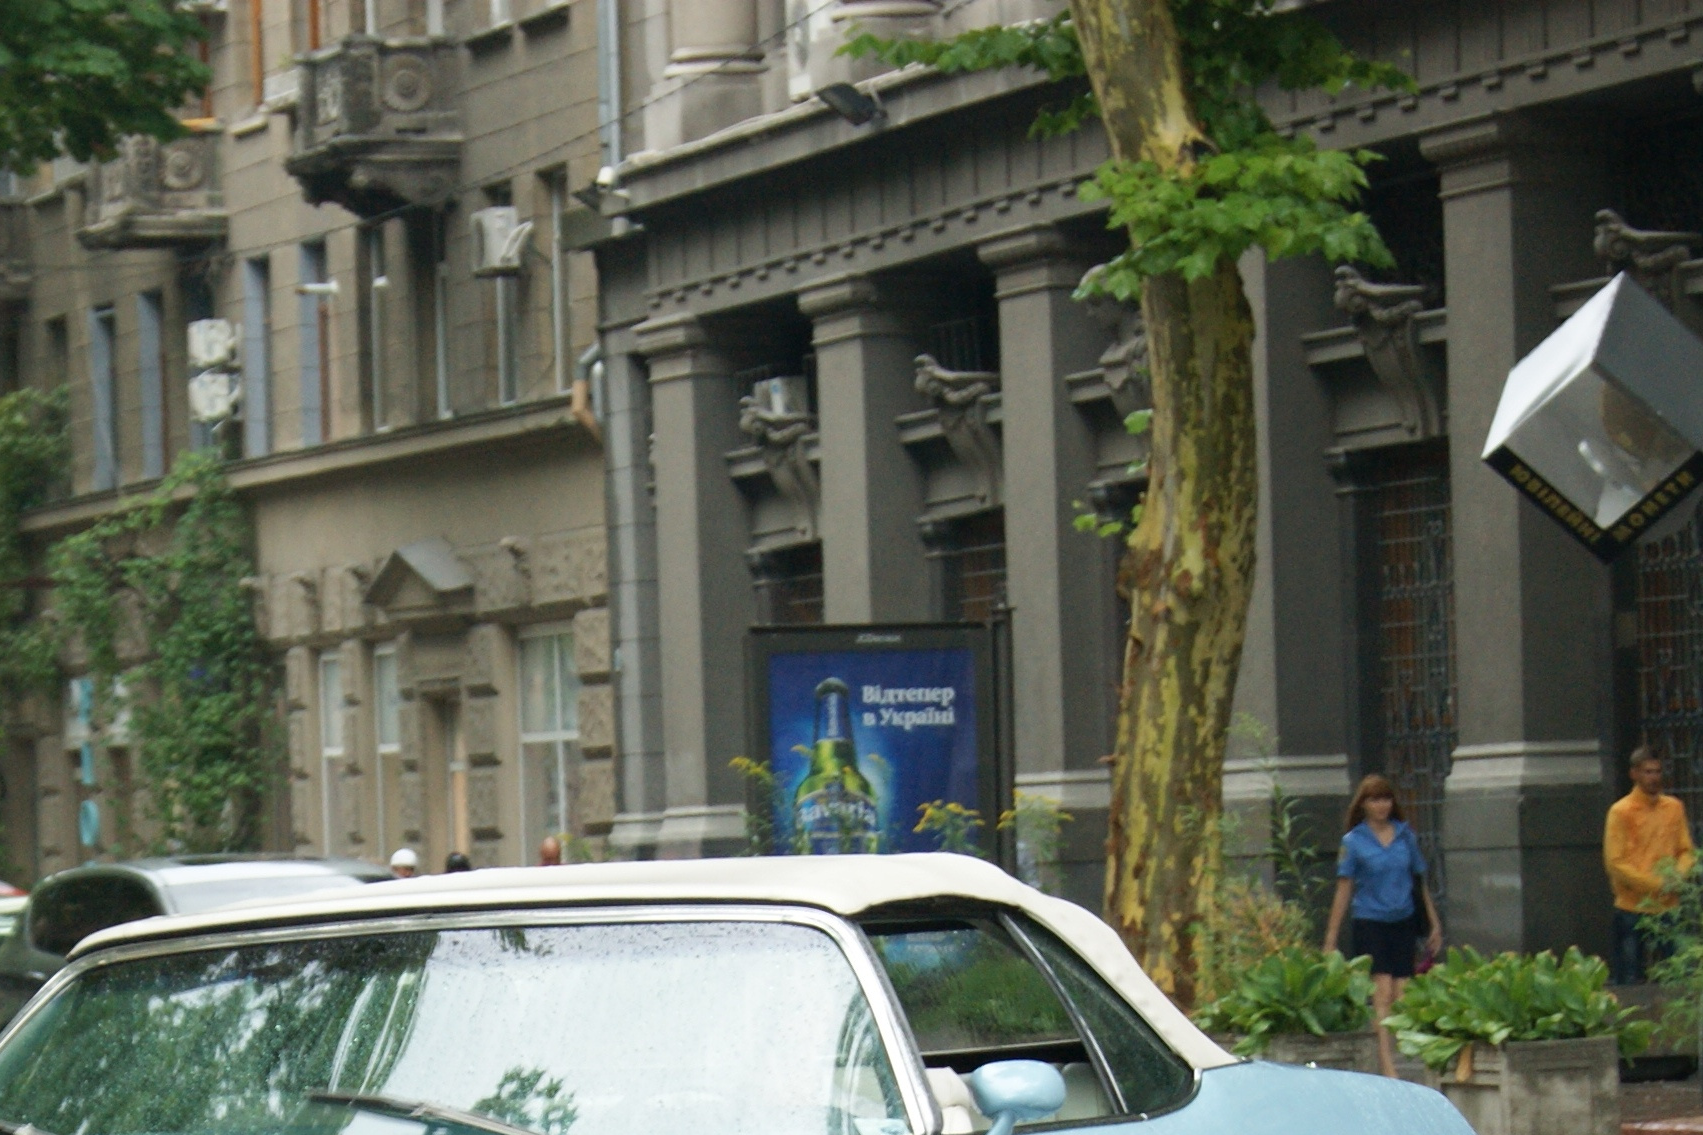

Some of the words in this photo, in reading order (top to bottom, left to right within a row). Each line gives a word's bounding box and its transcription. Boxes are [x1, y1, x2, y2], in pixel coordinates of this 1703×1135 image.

[862, 685, 955, 706] Відтепер
[863, 712, 876, 726] в
[880, 706, 955, 731] Україні
